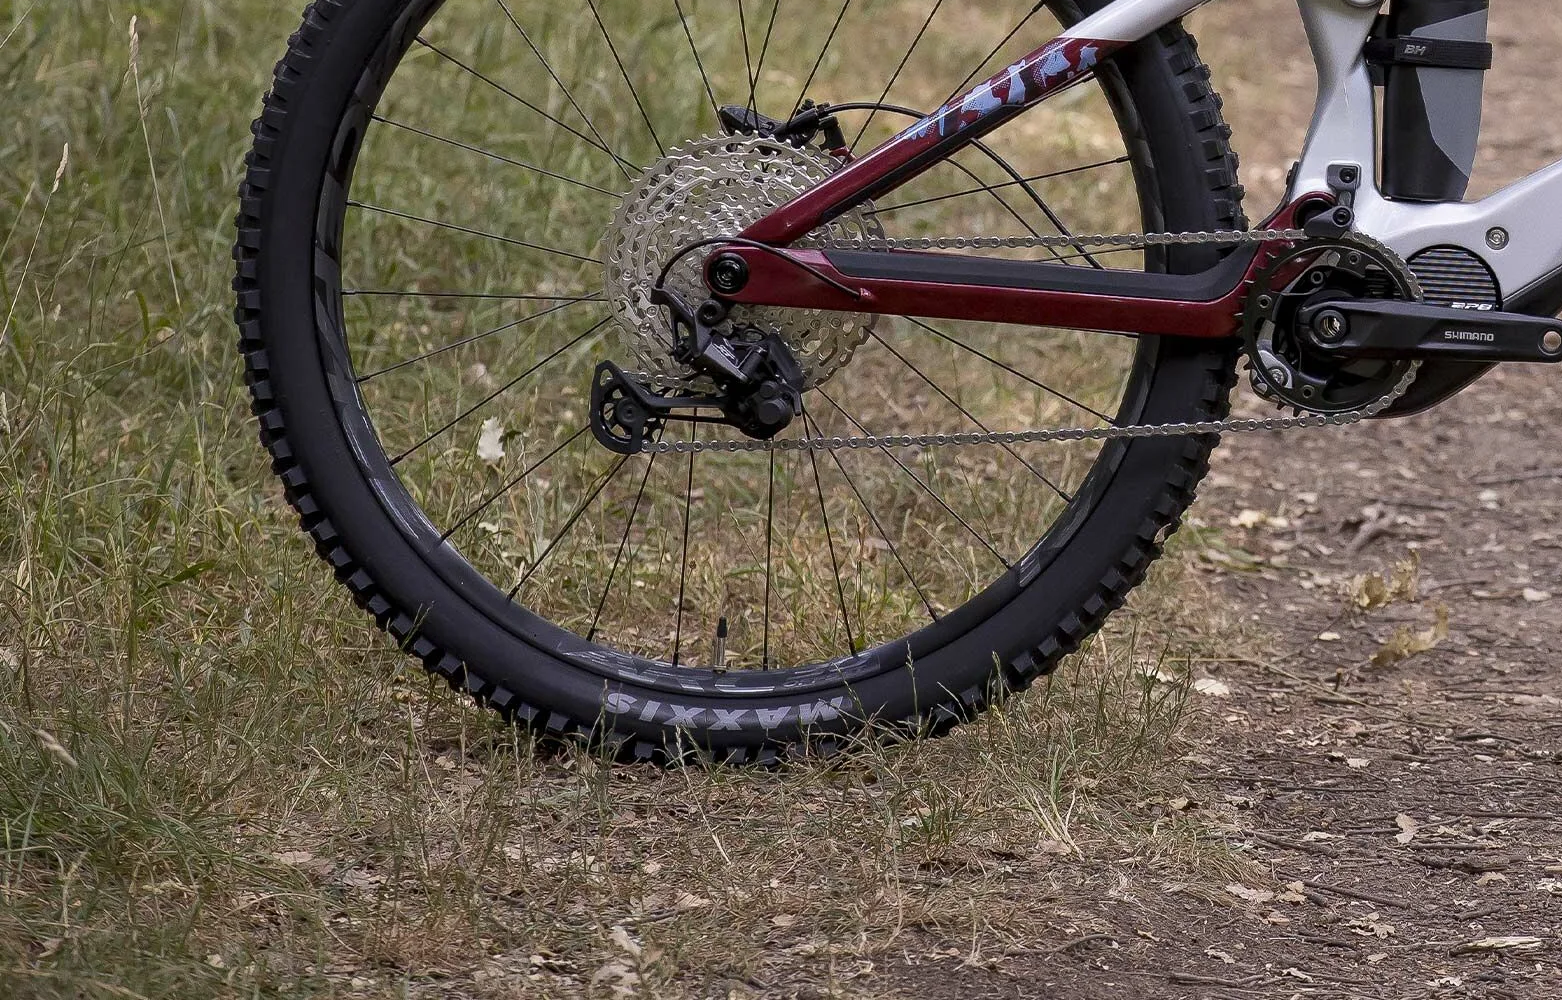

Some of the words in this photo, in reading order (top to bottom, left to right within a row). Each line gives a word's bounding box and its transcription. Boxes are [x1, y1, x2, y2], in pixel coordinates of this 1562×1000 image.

[1404, 44, 1427, 56] BH
[1444, 330, 1495, 342] SHIMANO
[605, 692, 844, 731] MAXXIS
